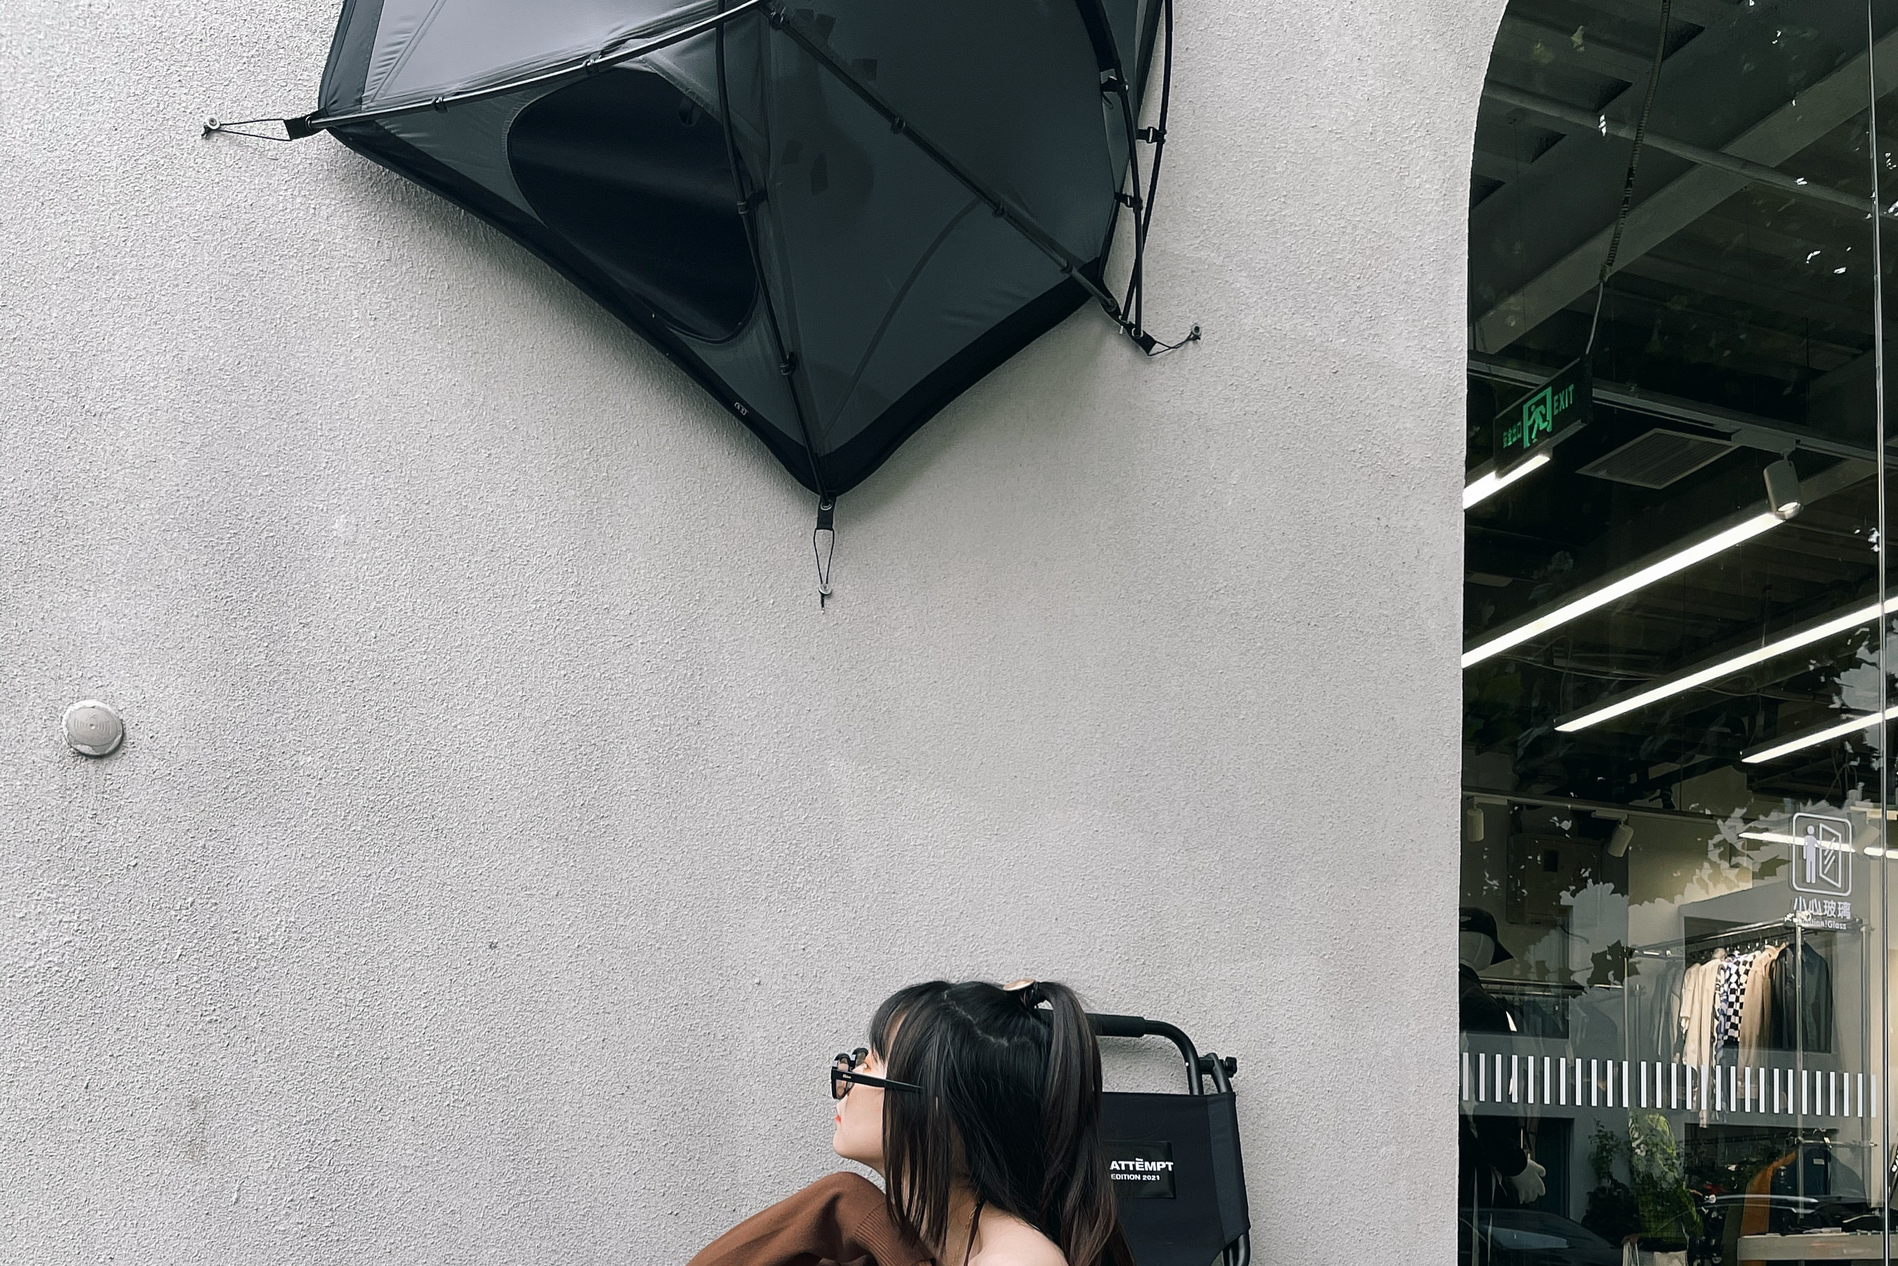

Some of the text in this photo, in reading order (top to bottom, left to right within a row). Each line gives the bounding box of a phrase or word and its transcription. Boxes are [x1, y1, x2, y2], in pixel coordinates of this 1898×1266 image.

[1553, 384, 1574, 415] EXIT
[1793, 895, 1852, 920] 小心玻璃
[1110, 1173, 1142, 1181] EDITION
